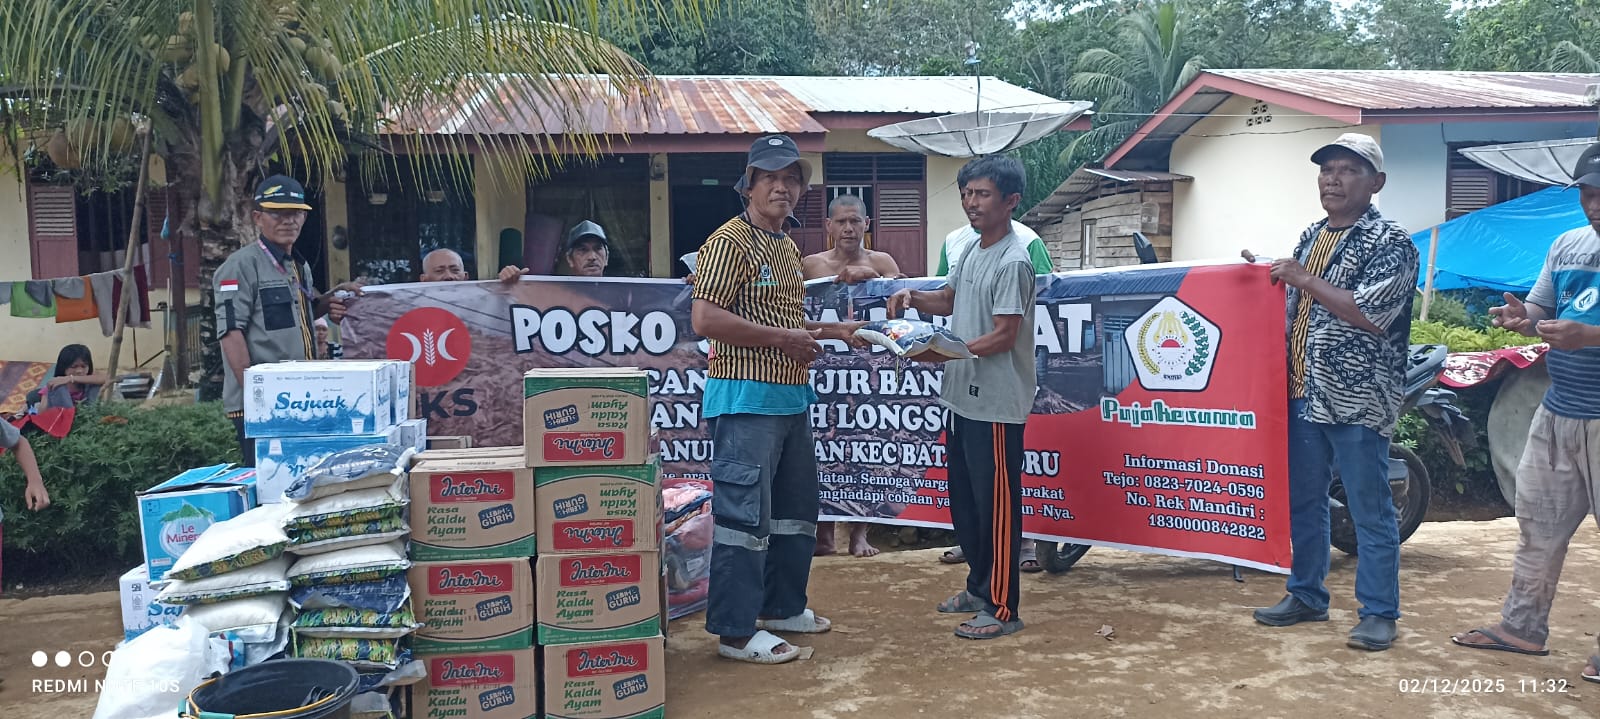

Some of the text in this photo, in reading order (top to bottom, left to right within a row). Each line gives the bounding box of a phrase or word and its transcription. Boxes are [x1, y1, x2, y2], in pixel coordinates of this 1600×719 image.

[511, 304, 677, 355] POSKO
[811, 370, 871, 396] JIR
[879, 370, 943, 396] BAN
[275, 391, 347, 412] Sajuak
[420, 388, 478, 418] KS
[591, 399, 628, 410] Ayam
[545, 406, 577, 421] GURIH
[591, 411, 628, 421] Kaldu
[651, 402, 701, 429] AN
[837, 403, 947, 432] LONGS
[598, 421, 628, 430] Rasa
[660, 440, 1060, 476] ANU AN KEC BAT RU
[1124, 454, 1264, 479] Informasi Donasi
[819, 471, 857, 484] latan.
[861, 473, 910, 489] Semoga
[1022, 486, 1064, 500] arakat
[1103, 471, 1264, 499] Tejo: 0823-7024-0596
[600, 487, 637, 497] Ayam
[819, 488, 884, 504] enghadapi
[888, 493, 933, 505] cobaan
[936, 496, 950, 508] ya
[555, 496, 585, 511] GURIH
[600, 499, 637, 509] Kaldu
[1126, 491, 1151, 507] No.
[1154, 494, 1185, 511] Rek
[1189, 497, 1256, 518] Mandiri
[427, 506, 459, 514] Rasa
[607, 509, 637, 517] Rasa
[427, 515, 466, 525] Kaldu
[482, 511, 513, 527] GURIH
[182, 524, 194, 533] Le
[427, 526, 466, 537] Ayam
[1148, 514, 1266, 541] 1830000842822
[556, 590, 588, 598] Rasa
[424, 599, 457, 607] Rasa
[557, 597, 594, 608] Kaldu
[608, 593, 639, 609] GURIH
[425, 608, 464, 618] Kaldu
[480, 604, 511, 618] GURIH
[556, 609, 594, 620] Ayam
[425, 618, 464, 629] Ayam
[564, 680, 595, 688] Rasa
[616, 681, 647, 698] GURIH
[564, 687, 602, 699] Kaldu
[428, 696, 467, 707] Kaldu
[482, 694, 513, 709] GURIH
[564, 699, 602, 711] Ayam
[428, 707, 467, 719] Ayam
